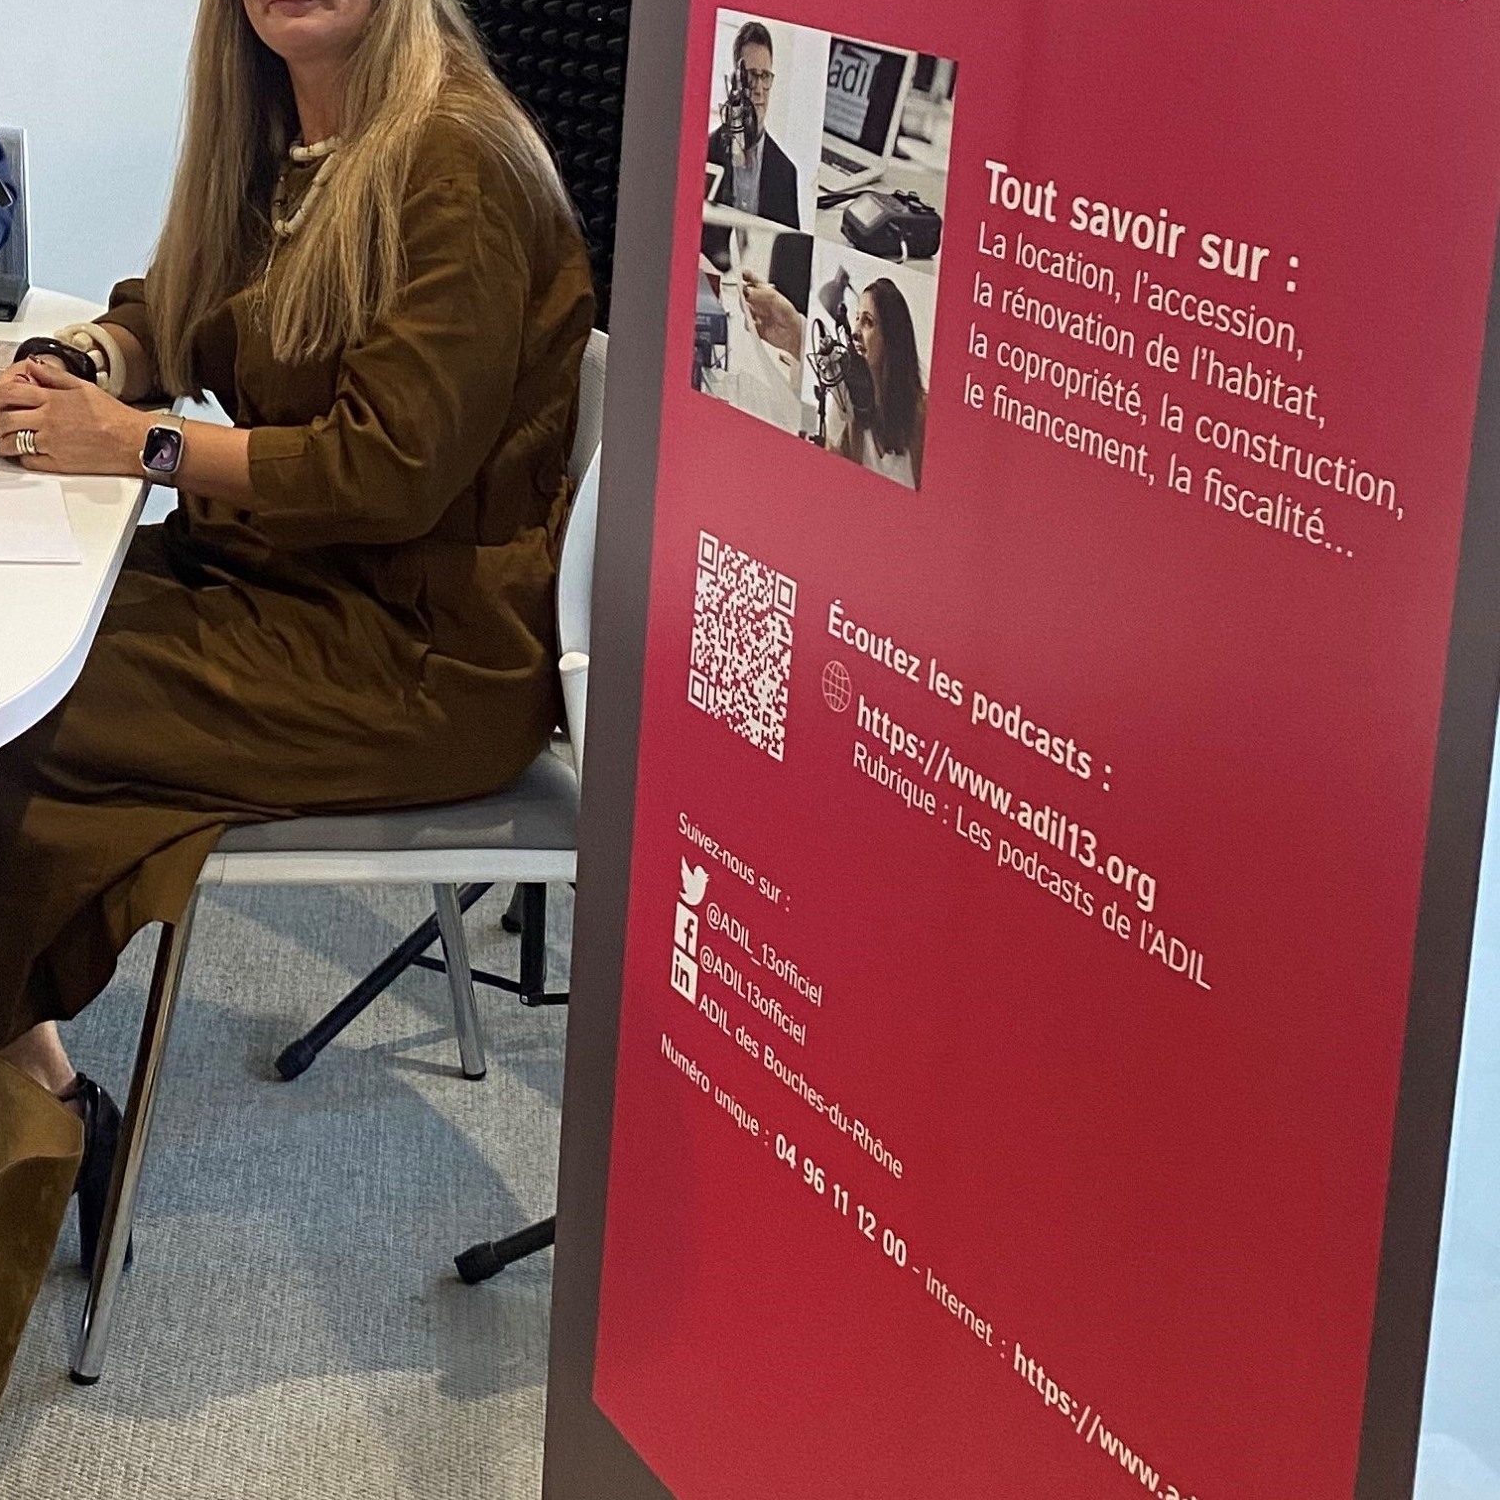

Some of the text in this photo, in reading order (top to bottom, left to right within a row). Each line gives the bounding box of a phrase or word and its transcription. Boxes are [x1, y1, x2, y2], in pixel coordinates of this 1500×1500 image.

[978, 221, 1303, 362] La location, l'accession,
[985, 159, 1058, 223] Tout
[1069, 196, 1186, 258] savoir
[1198, 233, 1270, 282] sur
[968, 322, 1404, 521] la copropriété, la construction,
[973, 271, 1325, 429] la rénovation de l'habitat,
[963, 372, 1353, 558] le financement, la fiscalité...
[827, 599, 921, 683] Écoutez
[928, 658, 964, 706] les
[971, 691, 1092, 780] podcasts
[678, 812, 755, 886] Suivez-nous
[758, 876, 782, 904] sur
[853, 741, 936, 815] Rubrique
[956, 805, 992, 851] Les
[997, 839, 1094, 917] podcasts
[1102, 901, 1131, 940] de
[1139, 919, 1211, 990] l'ADIL
[857, 694, 1156, 912] https://www.adil13.org
[699, 945, 806, 1046] @ADIL13officiel
[706, 902, 823, 1007] @ADIL_13officiel
[698, 994, 903, 1179] ADIL des Bouches-du-Rhône
[661, 1033, 710, 1093] Numéro
[714, 1086, 760, 1137] unique
[775, 1133, 797, 1169] 04
[803, 1157, 825, 1195] 96
[833, 1183, 849, 1216] 11
[857, 1205, 877, 1242] 12
[882, 1228, 907, 1267] 00
[926, 1268, 993, 1347] Internet
[1013, 1342, 1197, 1500] https://www.a
